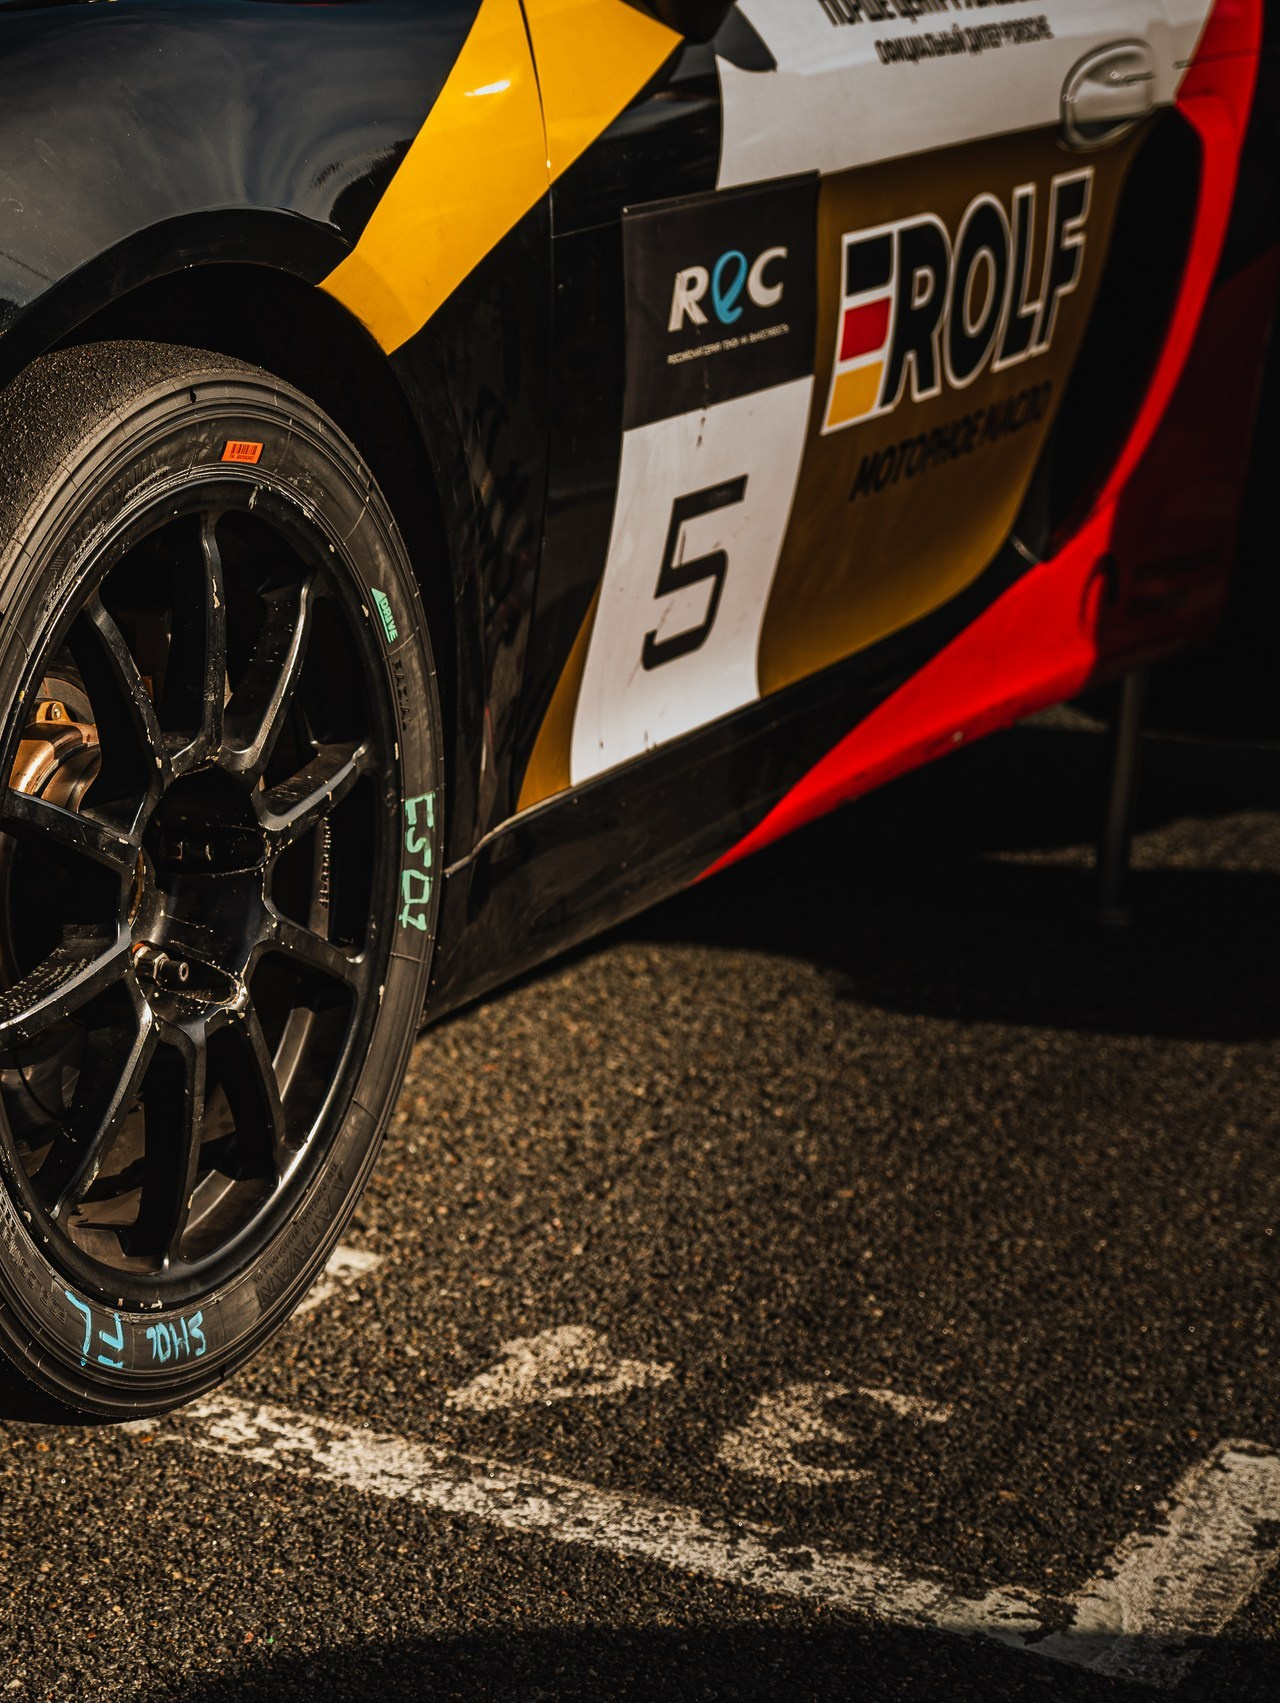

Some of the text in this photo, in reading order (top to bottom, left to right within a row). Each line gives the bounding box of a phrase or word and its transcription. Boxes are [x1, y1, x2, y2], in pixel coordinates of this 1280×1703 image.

[880, 165, 1094, 412] ROLF
[848, 379, 1053, 502] МОТОРНОЕ МАСЛО
[641, 472, 749, 672] 5
